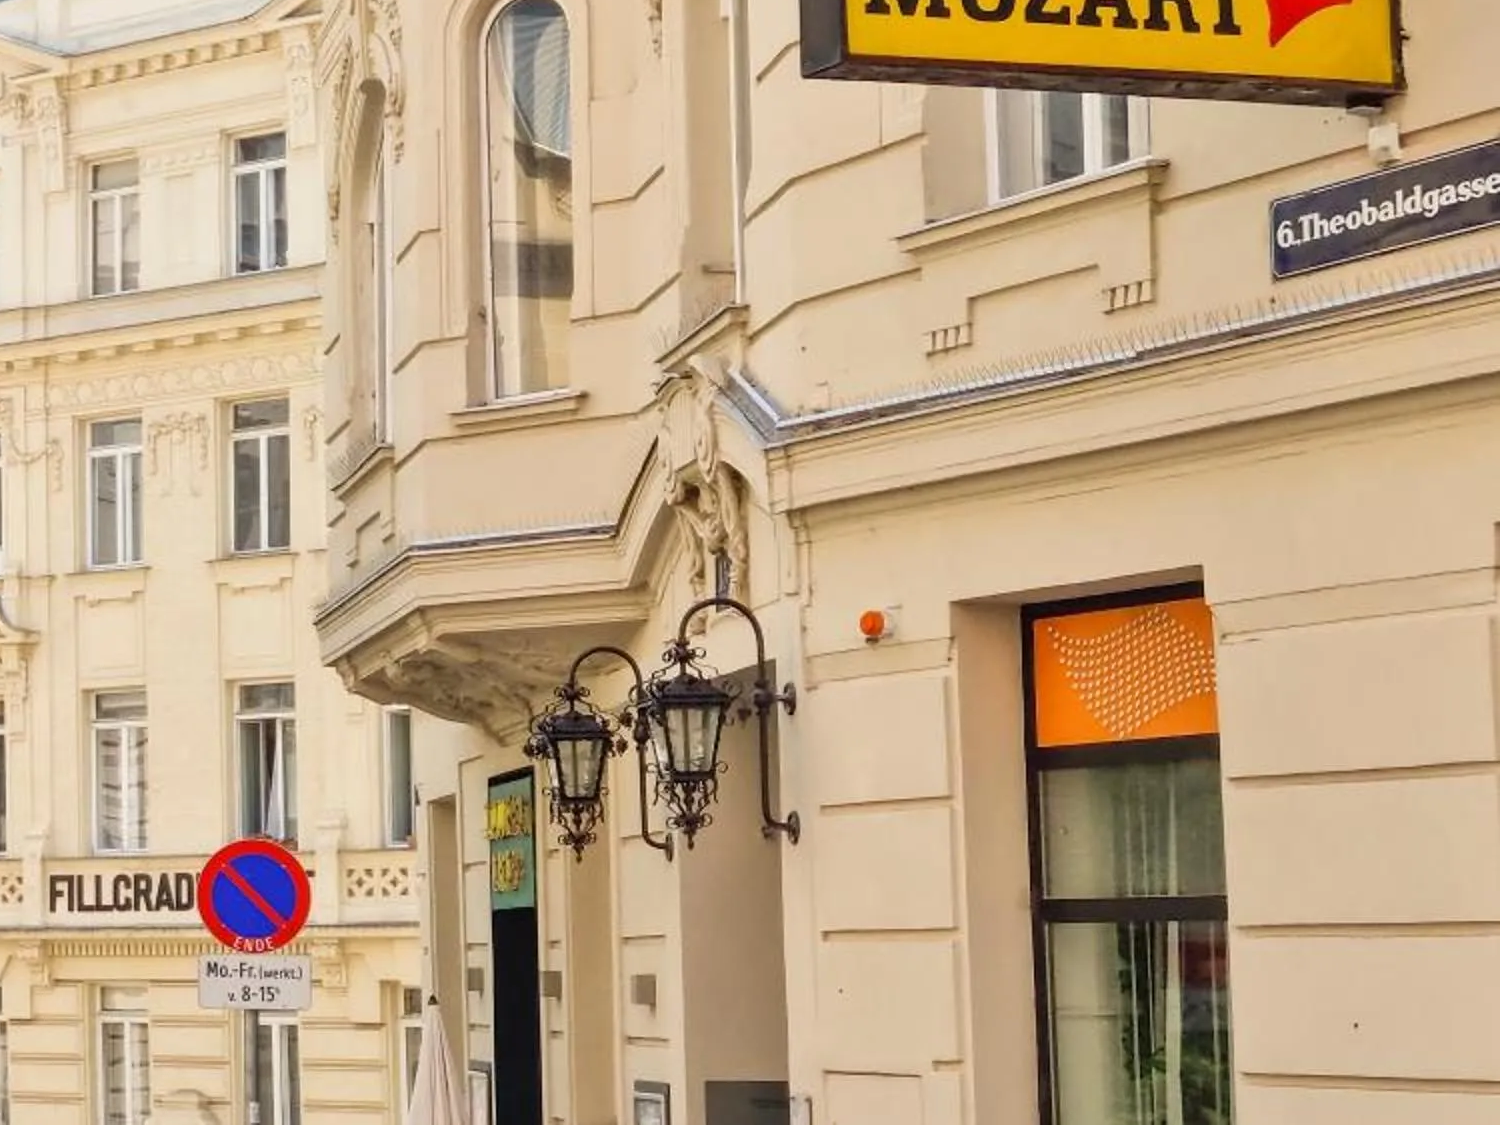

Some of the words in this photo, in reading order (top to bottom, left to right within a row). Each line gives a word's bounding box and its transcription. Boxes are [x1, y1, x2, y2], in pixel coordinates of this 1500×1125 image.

[233, 936, 275, 952] ENDE
[206, 960, 257, 979] Mo.-Fr.
[227, 991, 237, 1002] v.
